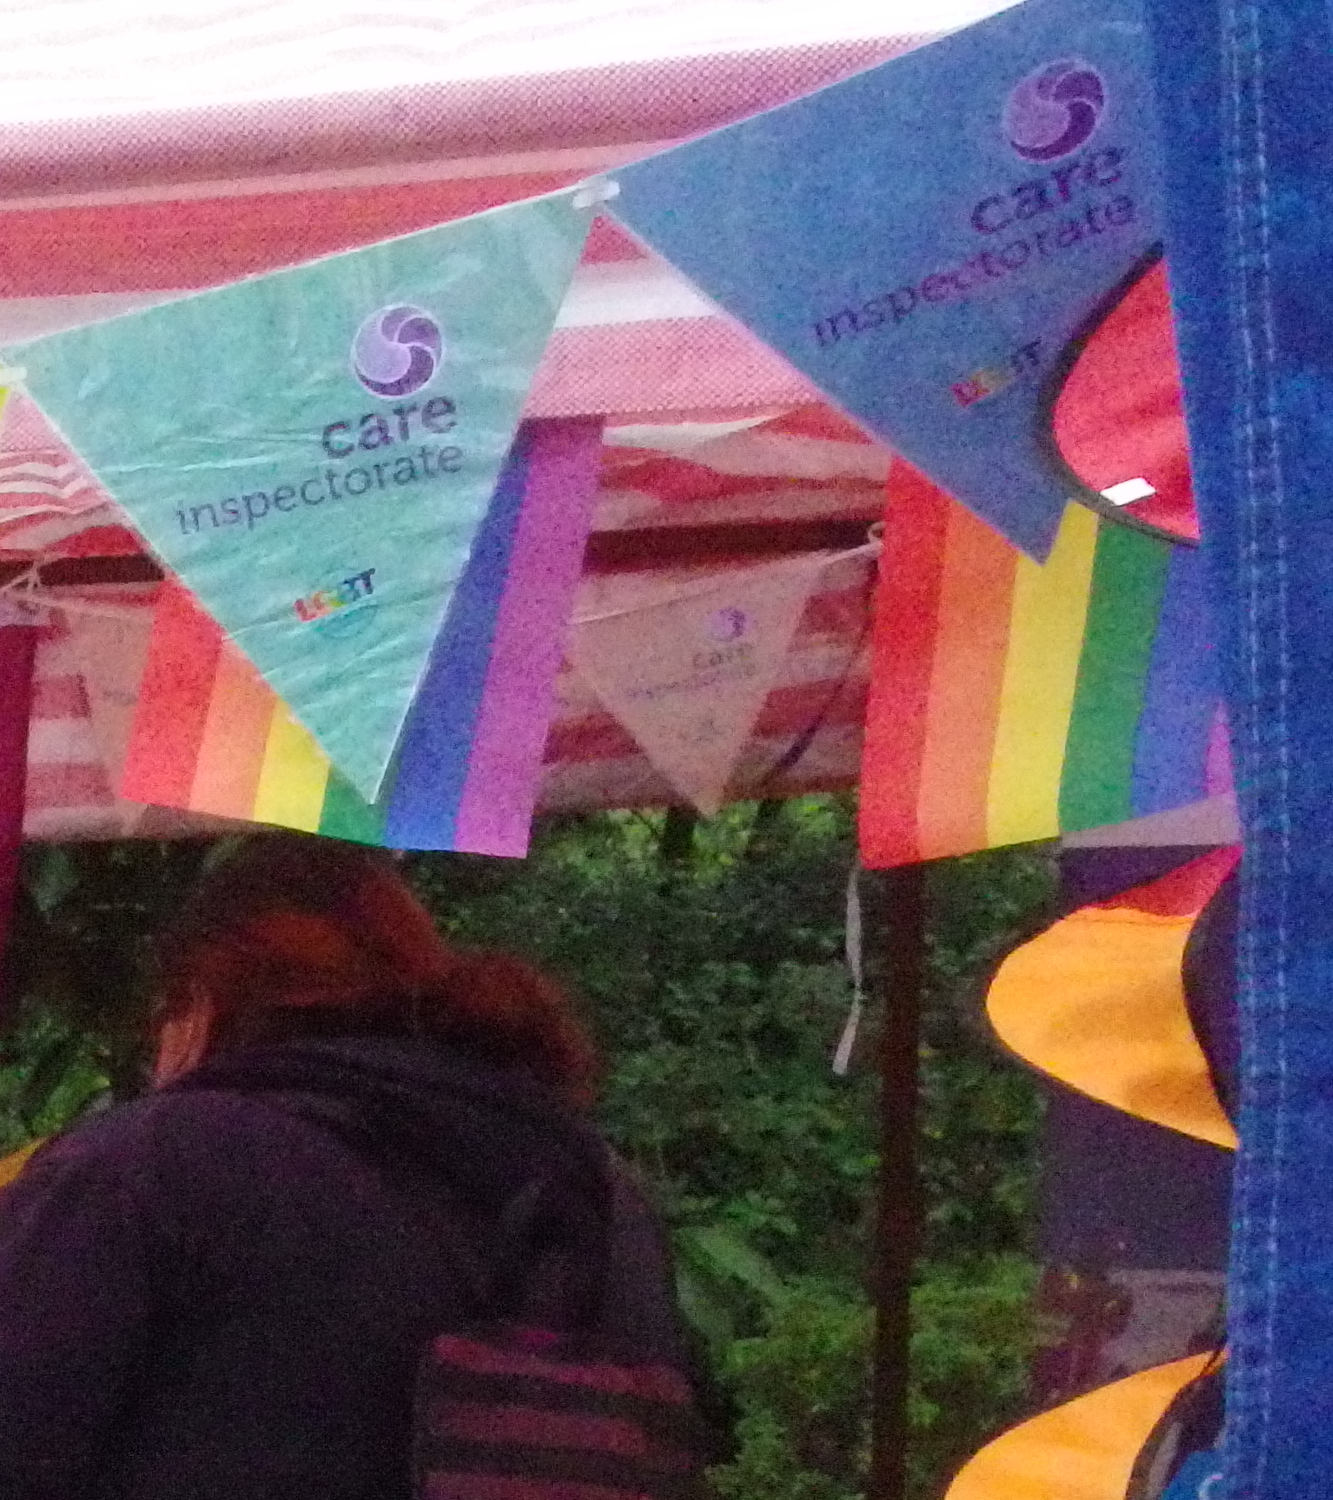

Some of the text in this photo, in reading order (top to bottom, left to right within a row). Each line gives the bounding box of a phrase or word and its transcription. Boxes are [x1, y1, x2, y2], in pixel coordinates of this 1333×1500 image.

[971, 146, 1125, 235] care
[811, 194, 1136, 347] inspectorate
[320, 393, 459, 460] care
[177, 438, 464, 537] inspectorate
